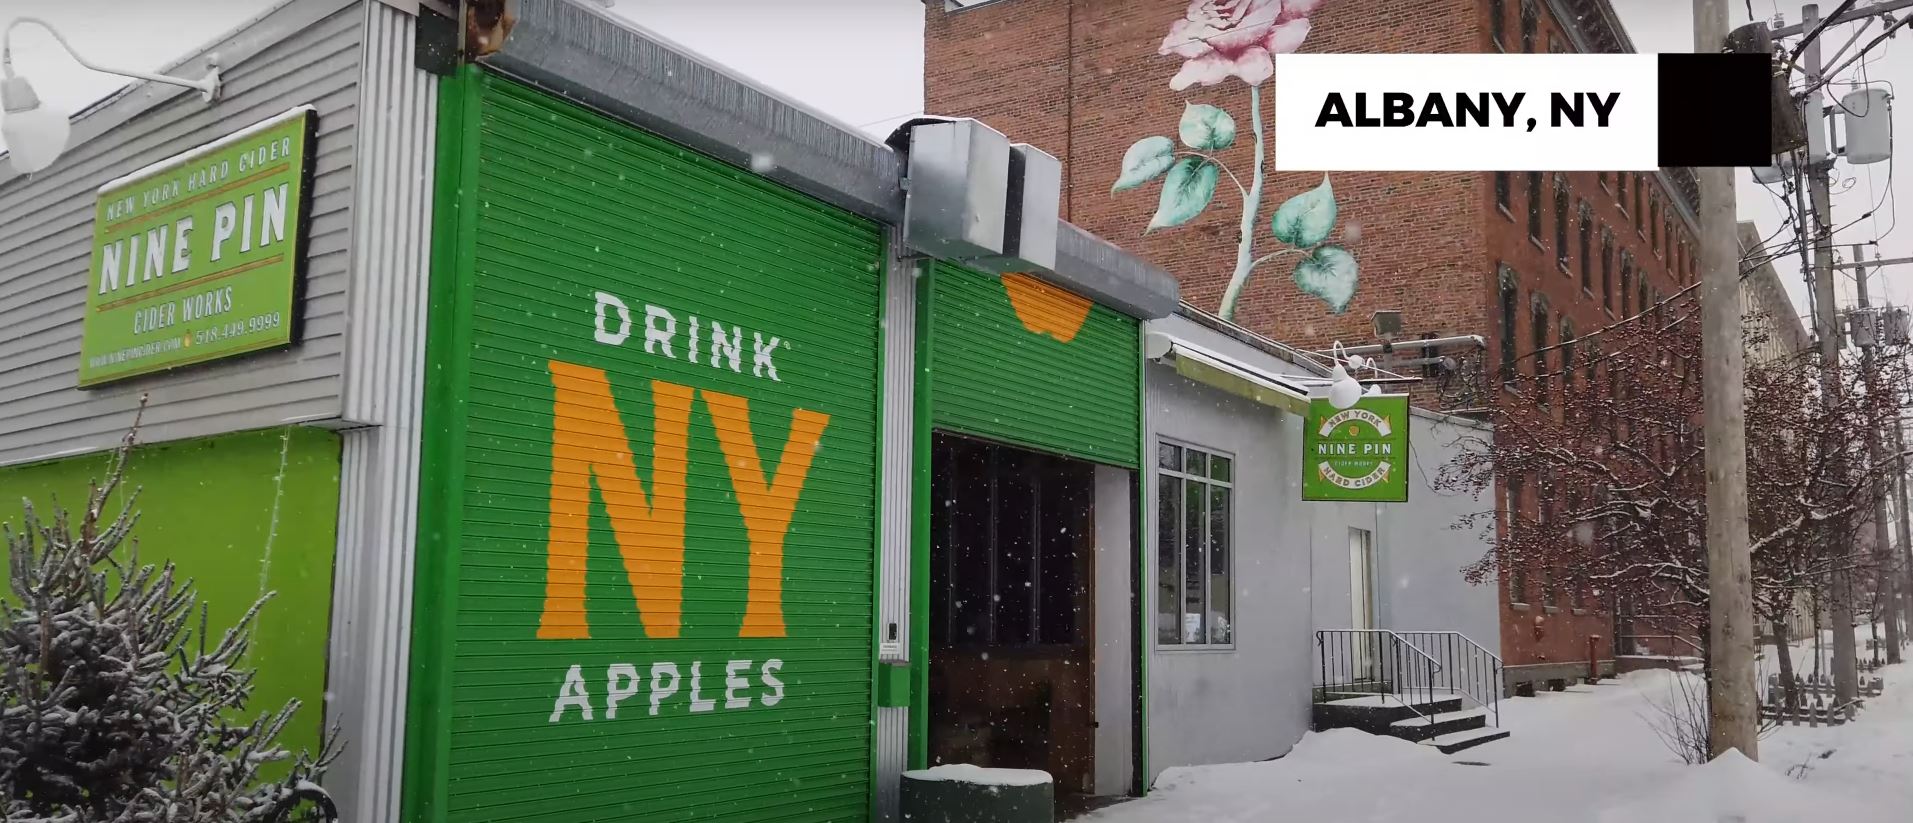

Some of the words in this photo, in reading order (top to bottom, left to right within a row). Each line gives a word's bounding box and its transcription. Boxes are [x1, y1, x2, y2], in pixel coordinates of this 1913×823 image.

[106, 196, 135, 222] NEW
[143, 186, 180, 210] YORK
[188, 160, 228, 192] HARD
[238, 136, 290, 172] CIDER
[98, 216, 194, 296] NINE
[210, 183, 289, 262] PIN
[133, 302, 176, 335] CIDER
[182, 286, 233, 323] WORKS
[196, 311, 280, 345] 518.449.9999
[595, 291, 781, 381] DRINK
[1328, 411, 1350, 428] NEW
[1354, 411, 1382, 427] YORK
[1318, 443, 1356, 455] NINE
[1363, 443, 1391, 455] PIN
[1323, 467, 1350, 486] HARD
[1354, 467, 1386, 487] CIDER
[536, 359, 831, 640] NY
[549, 658, 785, 722] APPLES
